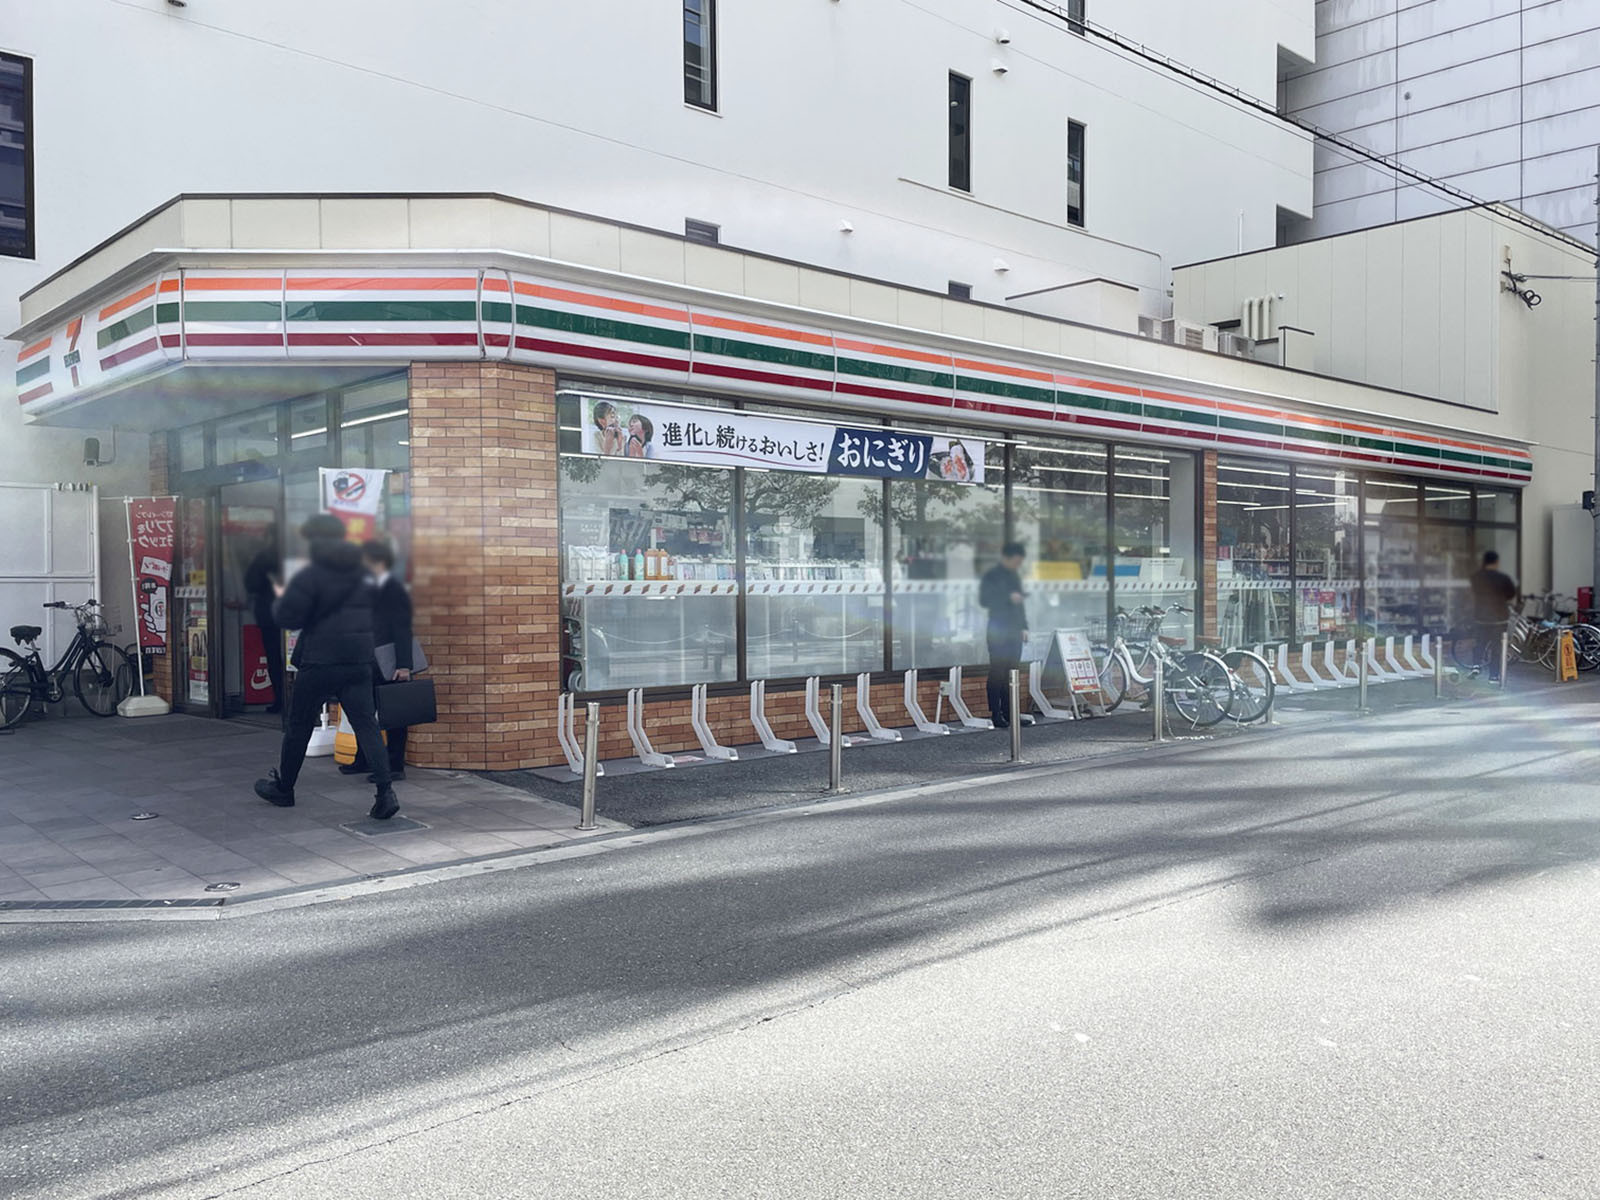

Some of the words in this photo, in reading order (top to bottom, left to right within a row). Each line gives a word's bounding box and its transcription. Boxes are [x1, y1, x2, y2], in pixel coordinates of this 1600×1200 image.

[662, 422, 824, 462] 進化し続けるおいしさ!
[837, 432, 924, 474] おにぎり
